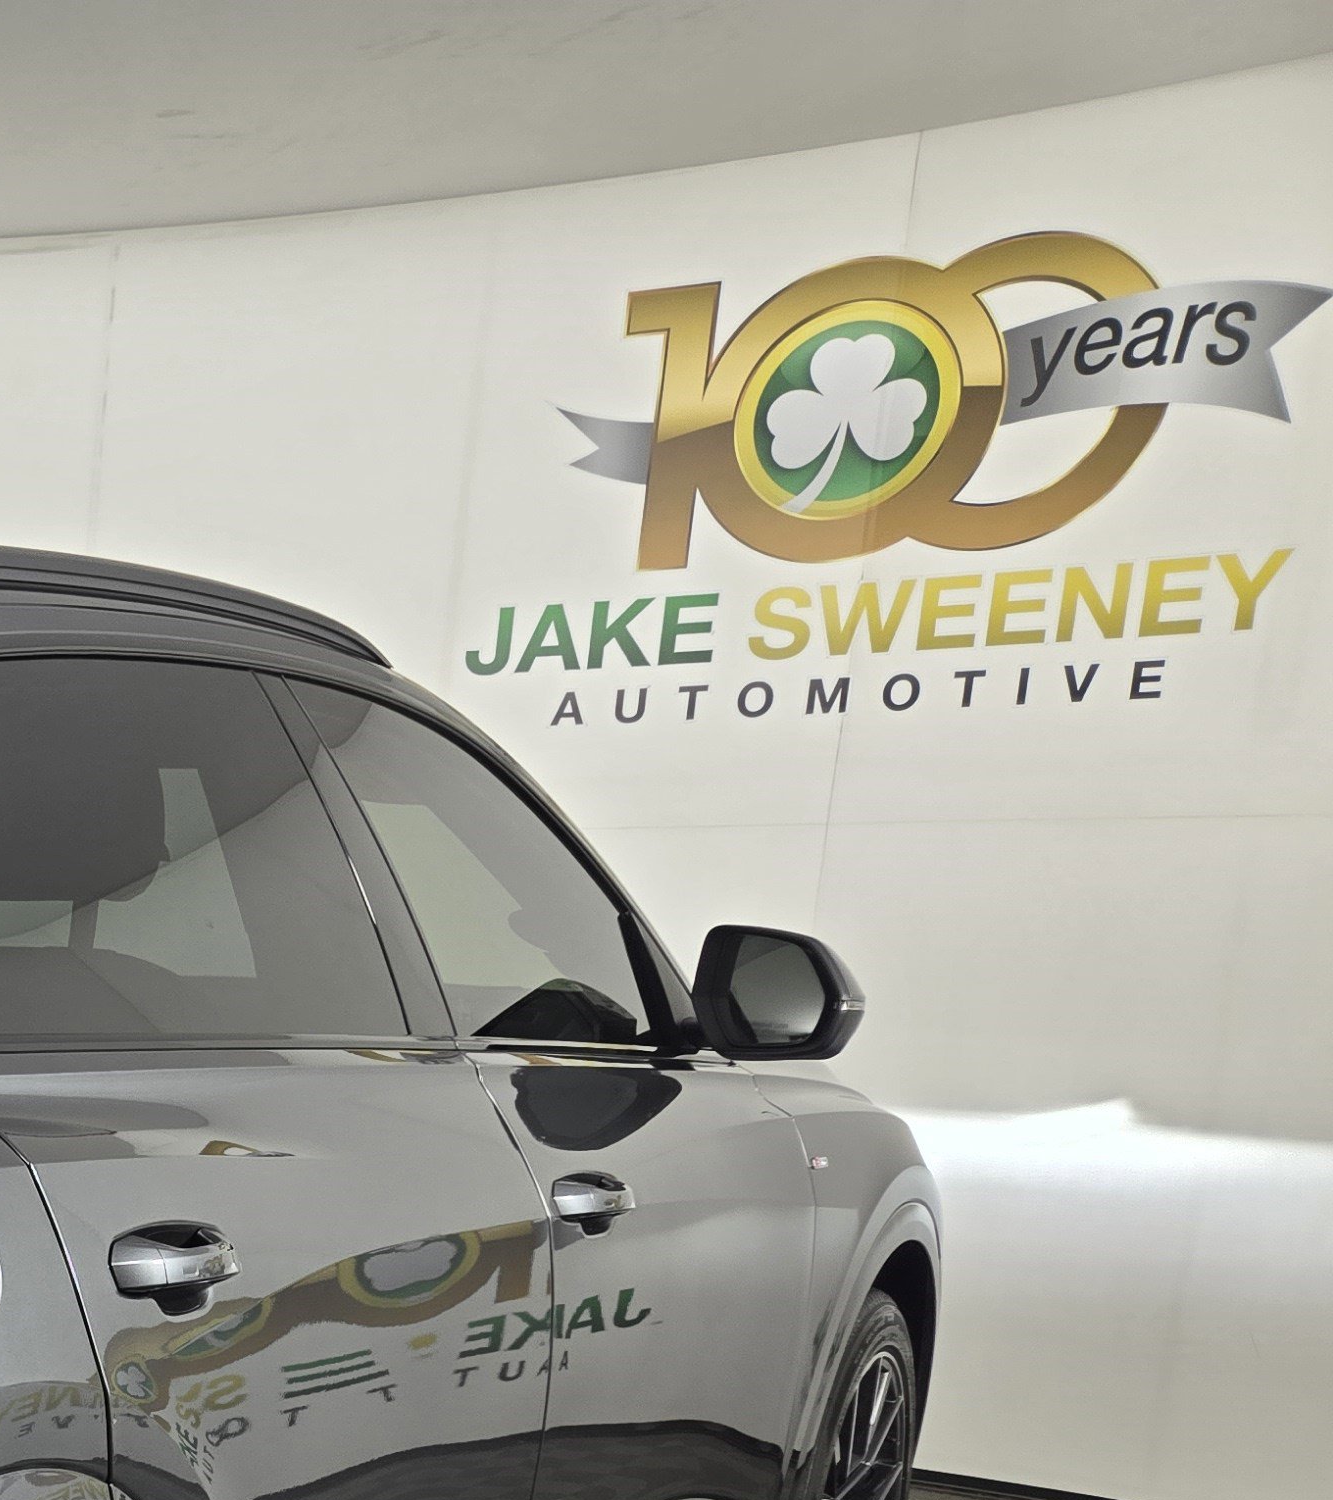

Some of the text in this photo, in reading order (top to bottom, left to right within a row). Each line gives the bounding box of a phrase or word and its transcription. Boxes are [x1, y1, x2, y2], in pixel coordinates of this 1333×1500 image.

[626, 230, 1257, 570] 100 years
[465, 548, 1294, 676] JAKE SWEENEY
[550, 659, 1167, 727] AUTOMOTIVE
